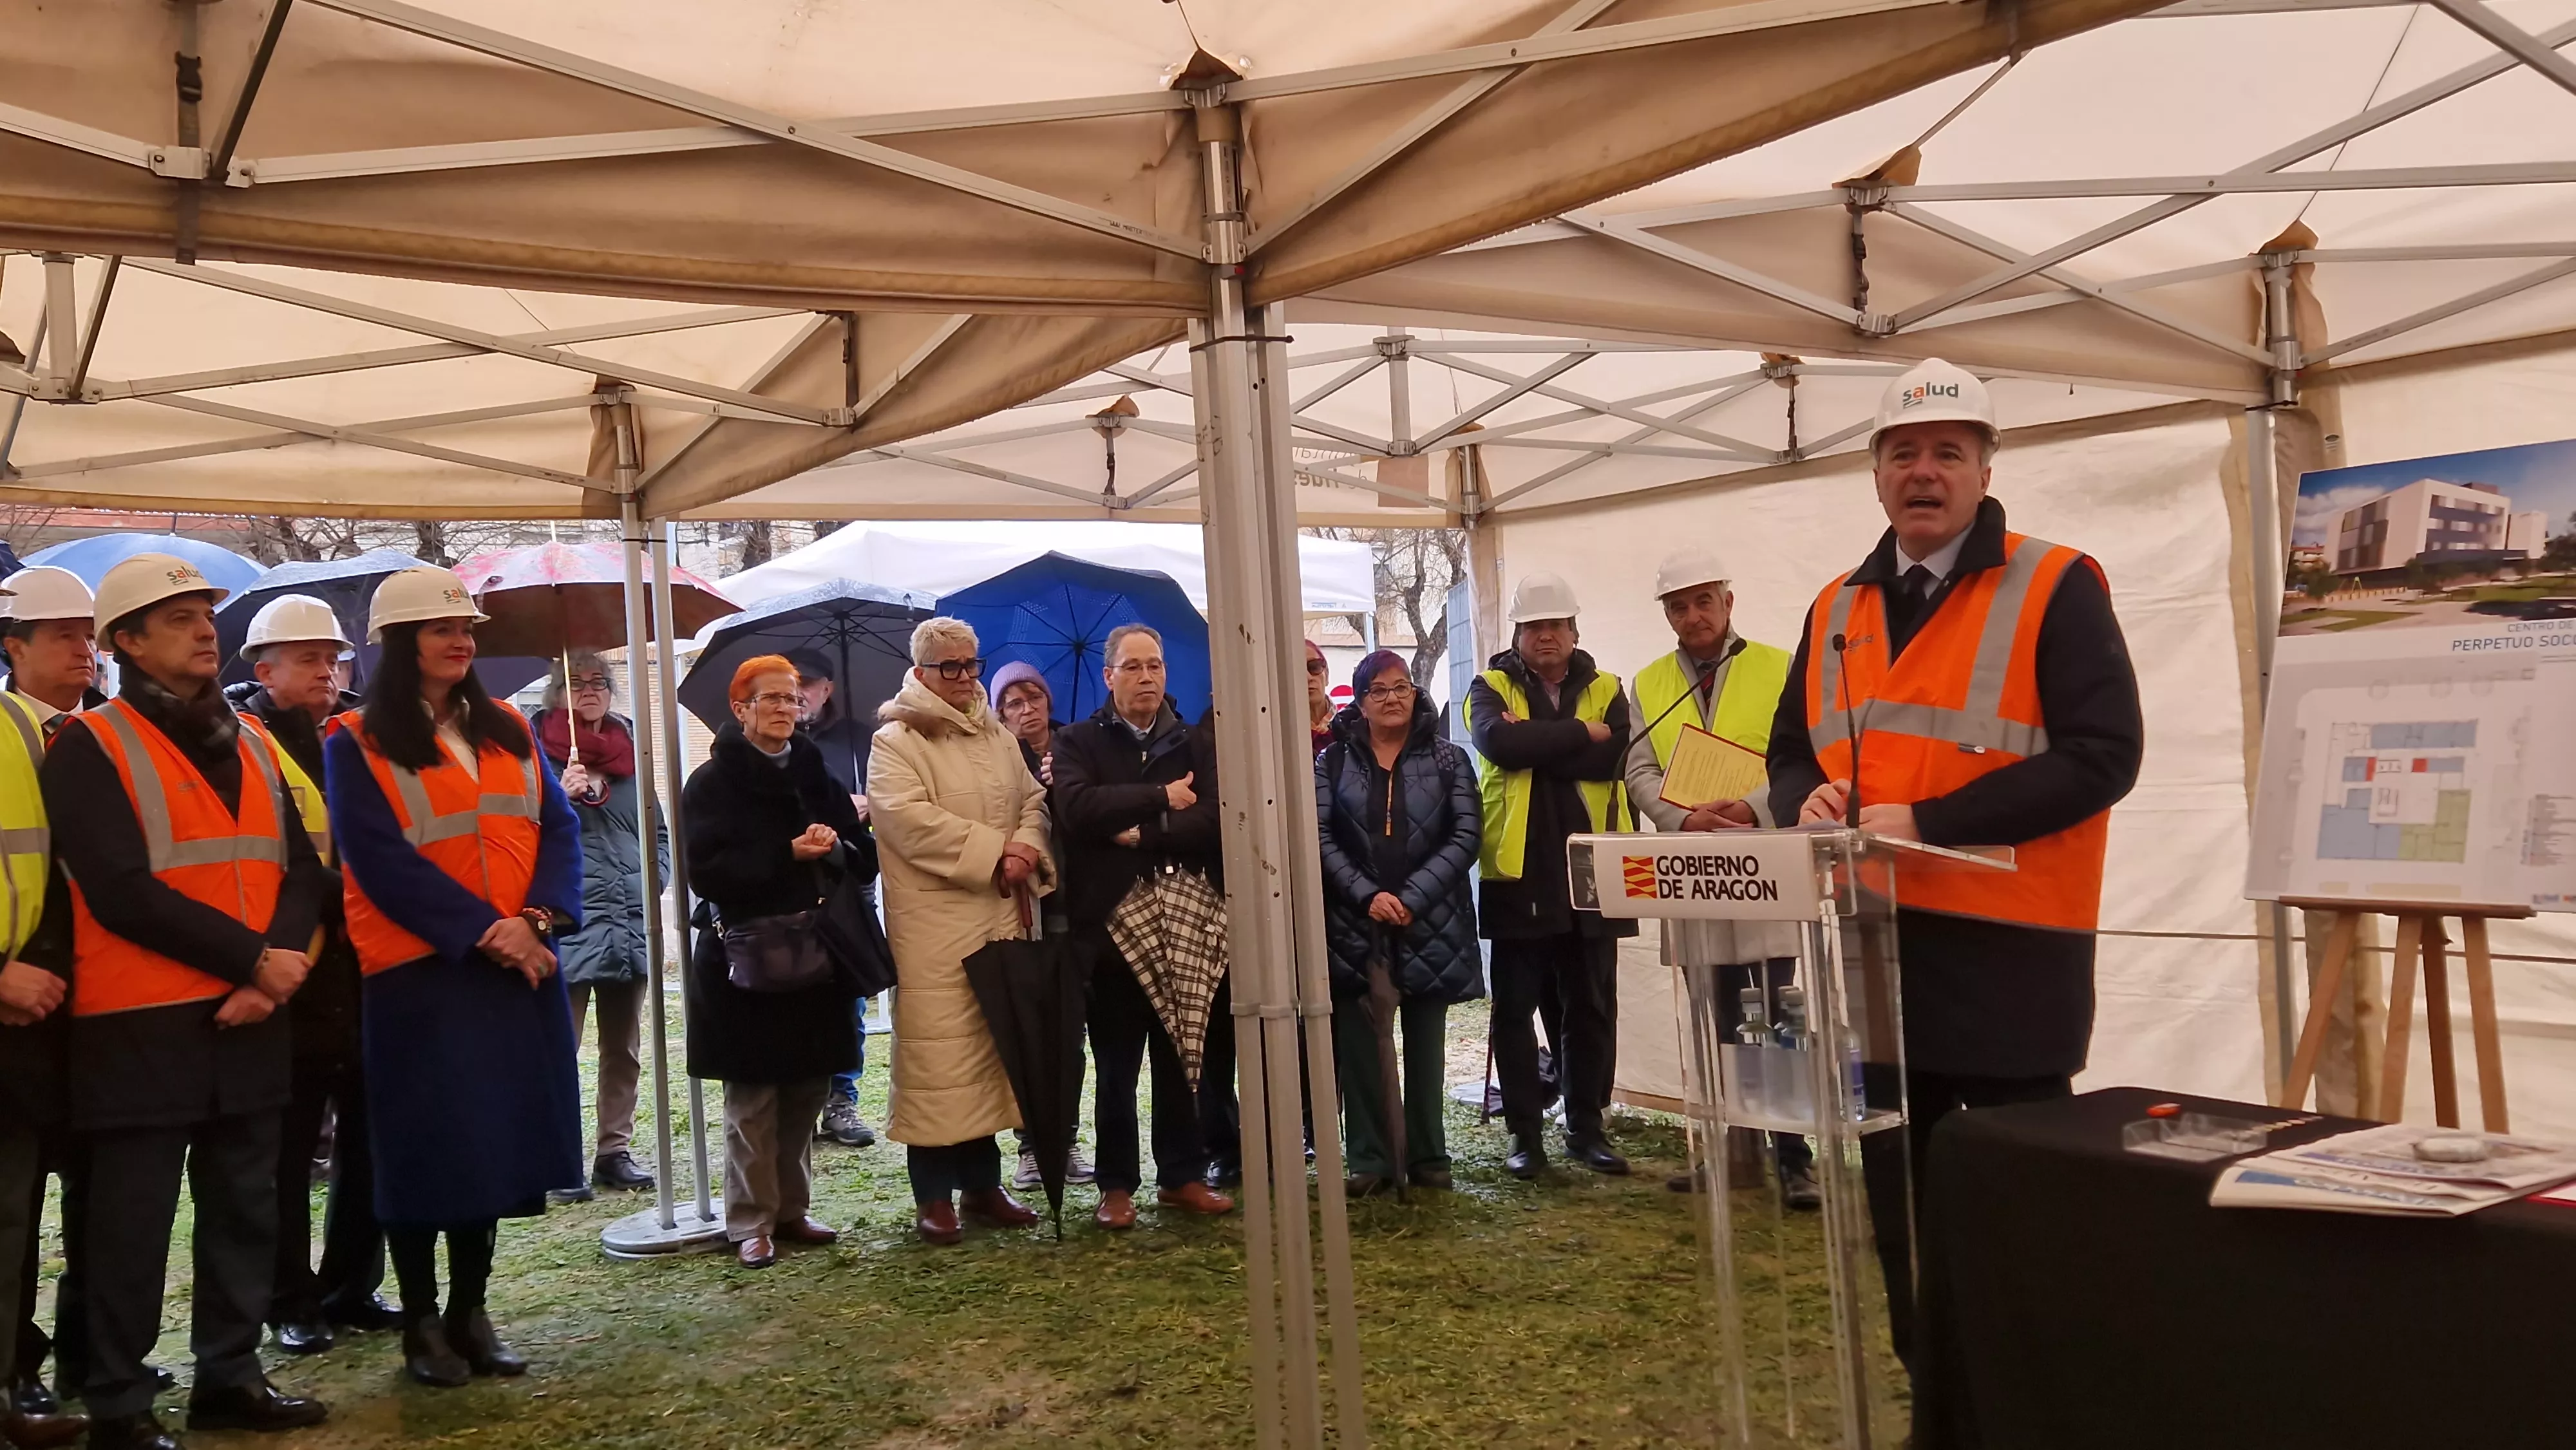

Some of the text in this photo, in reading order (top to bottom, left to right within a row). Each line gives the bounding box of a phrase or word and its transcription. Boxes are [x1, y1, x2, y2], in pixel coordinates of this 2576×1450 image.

[1902, 382, 1959, 402] salud
[2508, 620, 2574, 632] CENTRO DE
[2452, 634, 2576, 651] PERPETUO SOC
[1656, 855, 1759, 876] GOBIERNO
[1658, 879, 1778, 901] DE ARAGON
